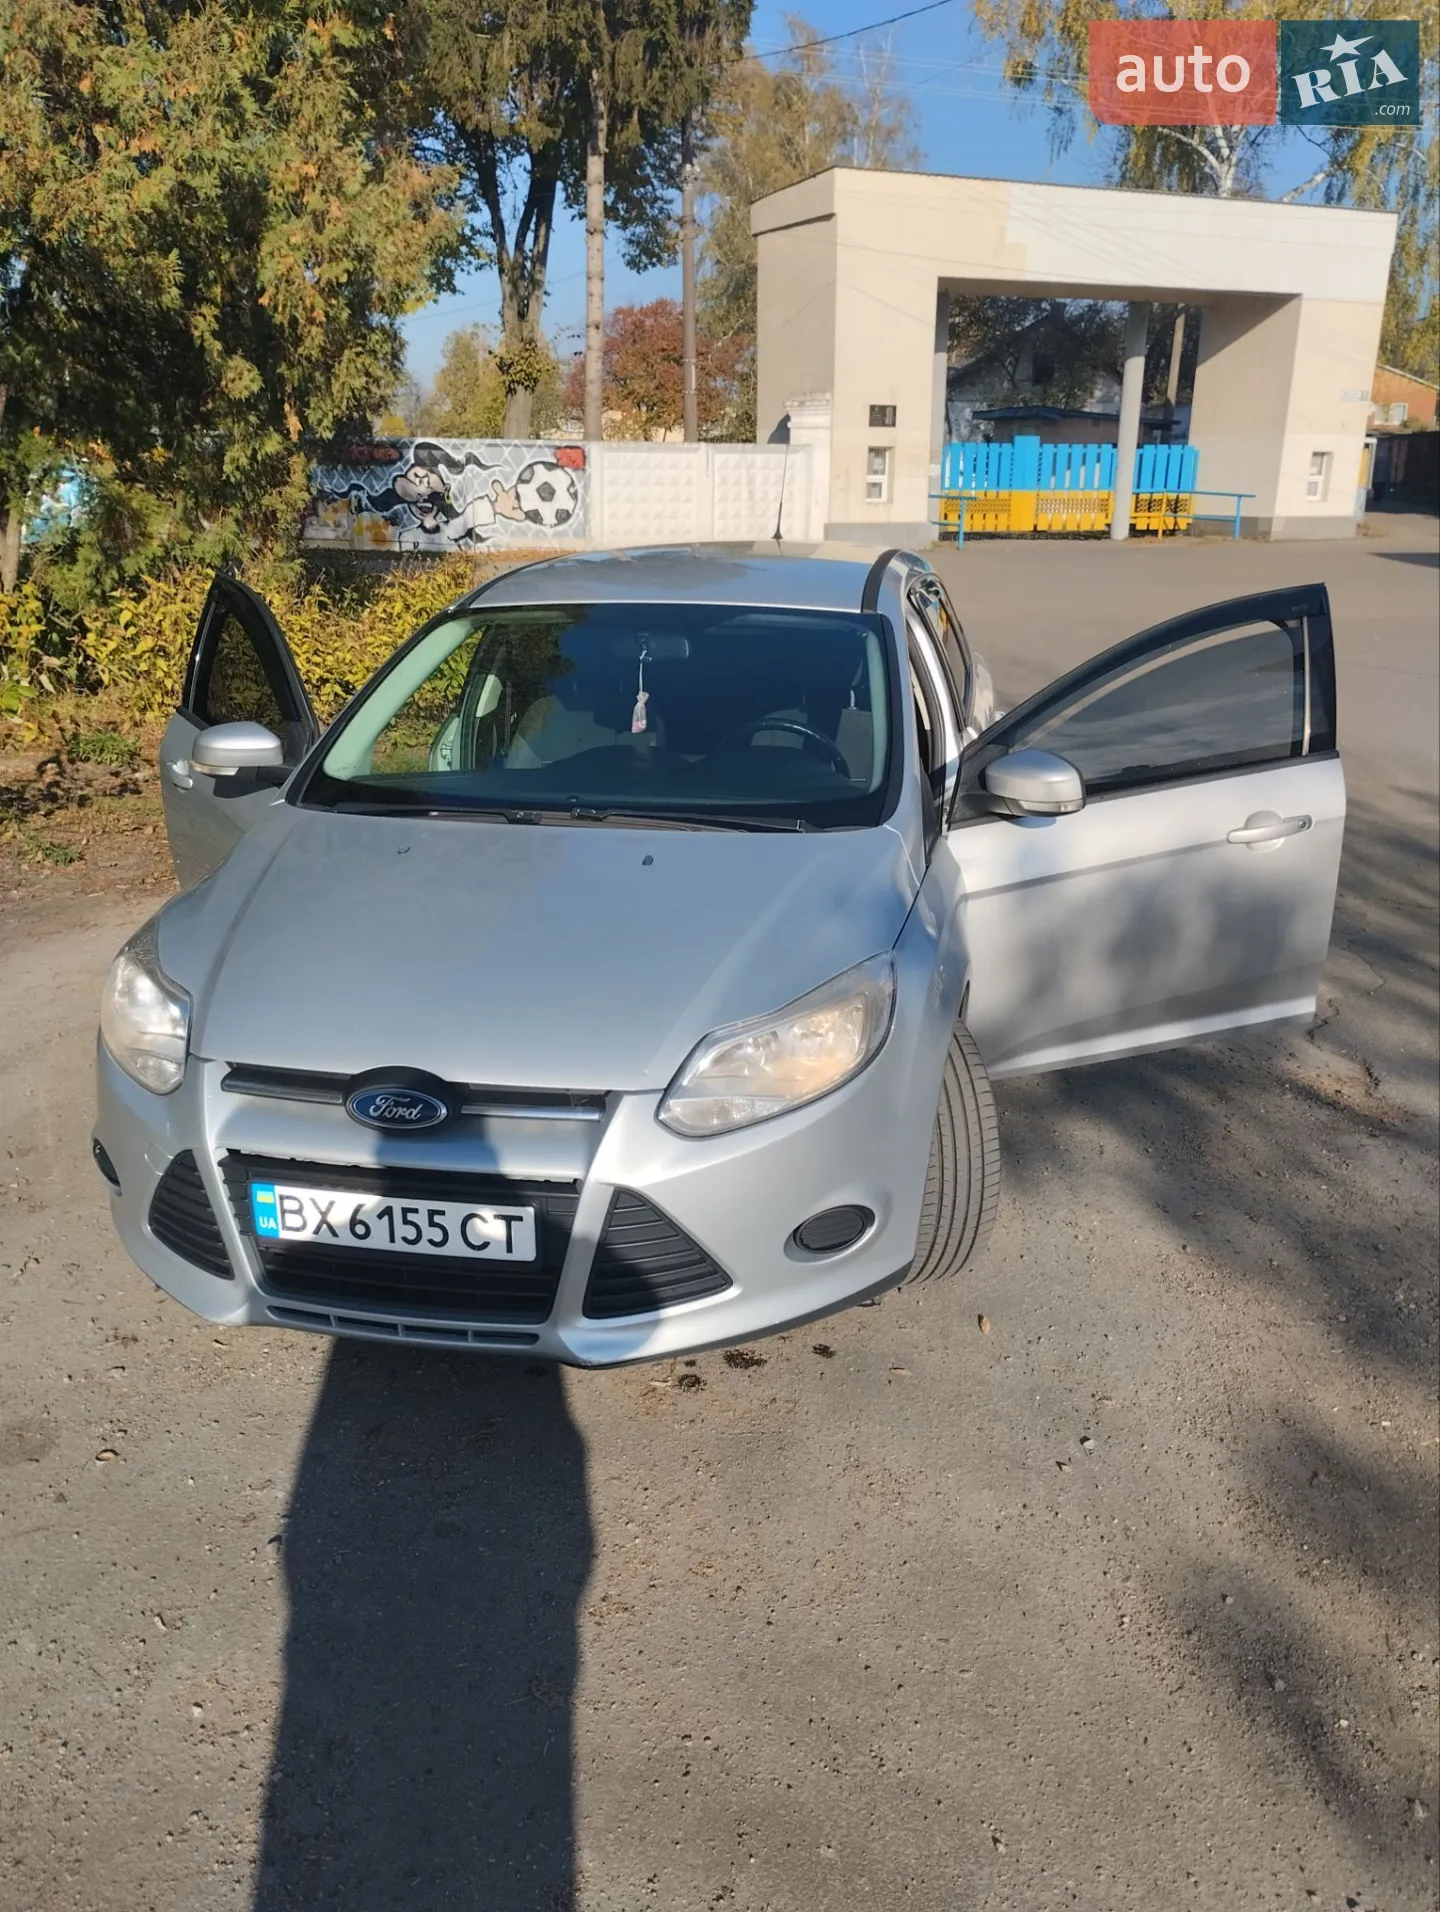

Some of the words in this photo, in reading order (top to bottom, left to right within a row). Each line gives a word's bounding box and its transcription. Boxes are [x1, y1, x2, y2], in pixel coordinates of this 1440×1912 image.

[368, 1094, 425, 1121] Ford
[259, 1215, 278, 1231] UA
[278, 1193, 340, 1239] BX
[349, 1203, 450, 1248] 6155
[460, 1212, 525, 1254] CT
